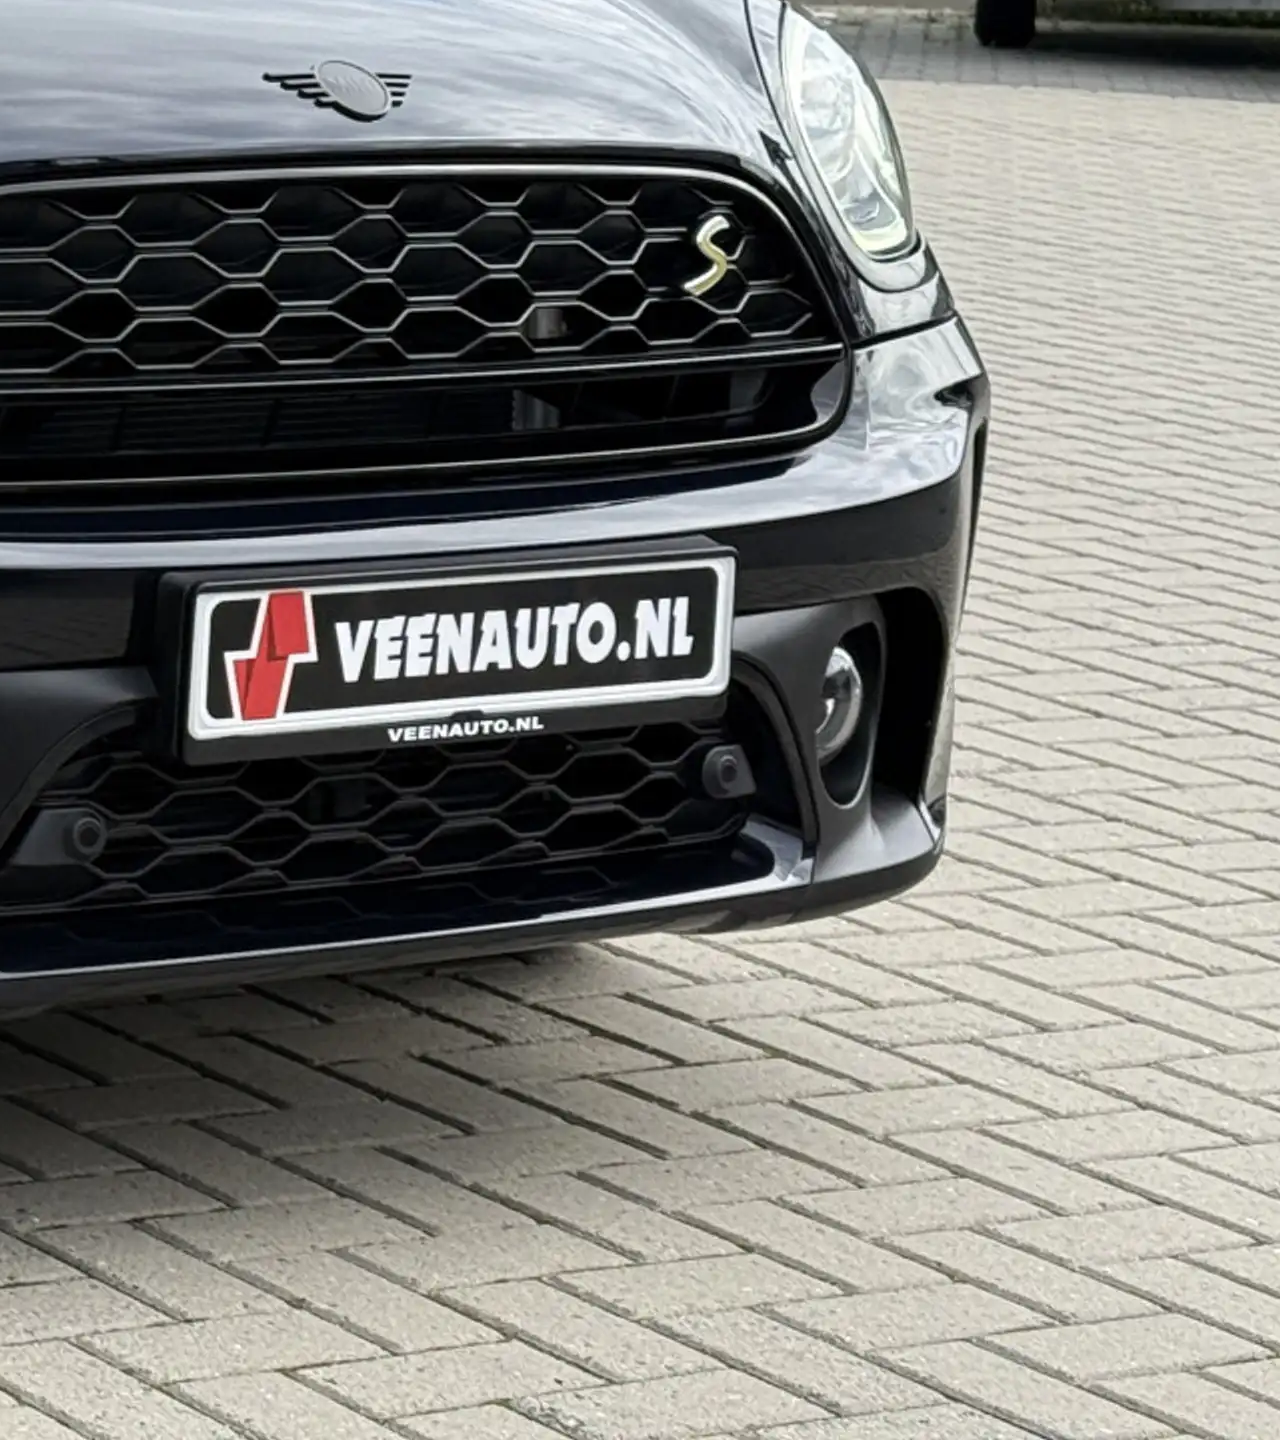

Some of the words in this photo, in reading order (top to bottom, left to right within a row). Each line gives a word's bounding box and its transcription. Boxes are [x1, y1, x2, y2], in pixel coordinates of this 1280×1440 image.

[684, 216, 730, 296] S
[335, 595, 696, 684] VEENAUTO.NL
[387, 715, 545, 742] VEENAUTO.NL
